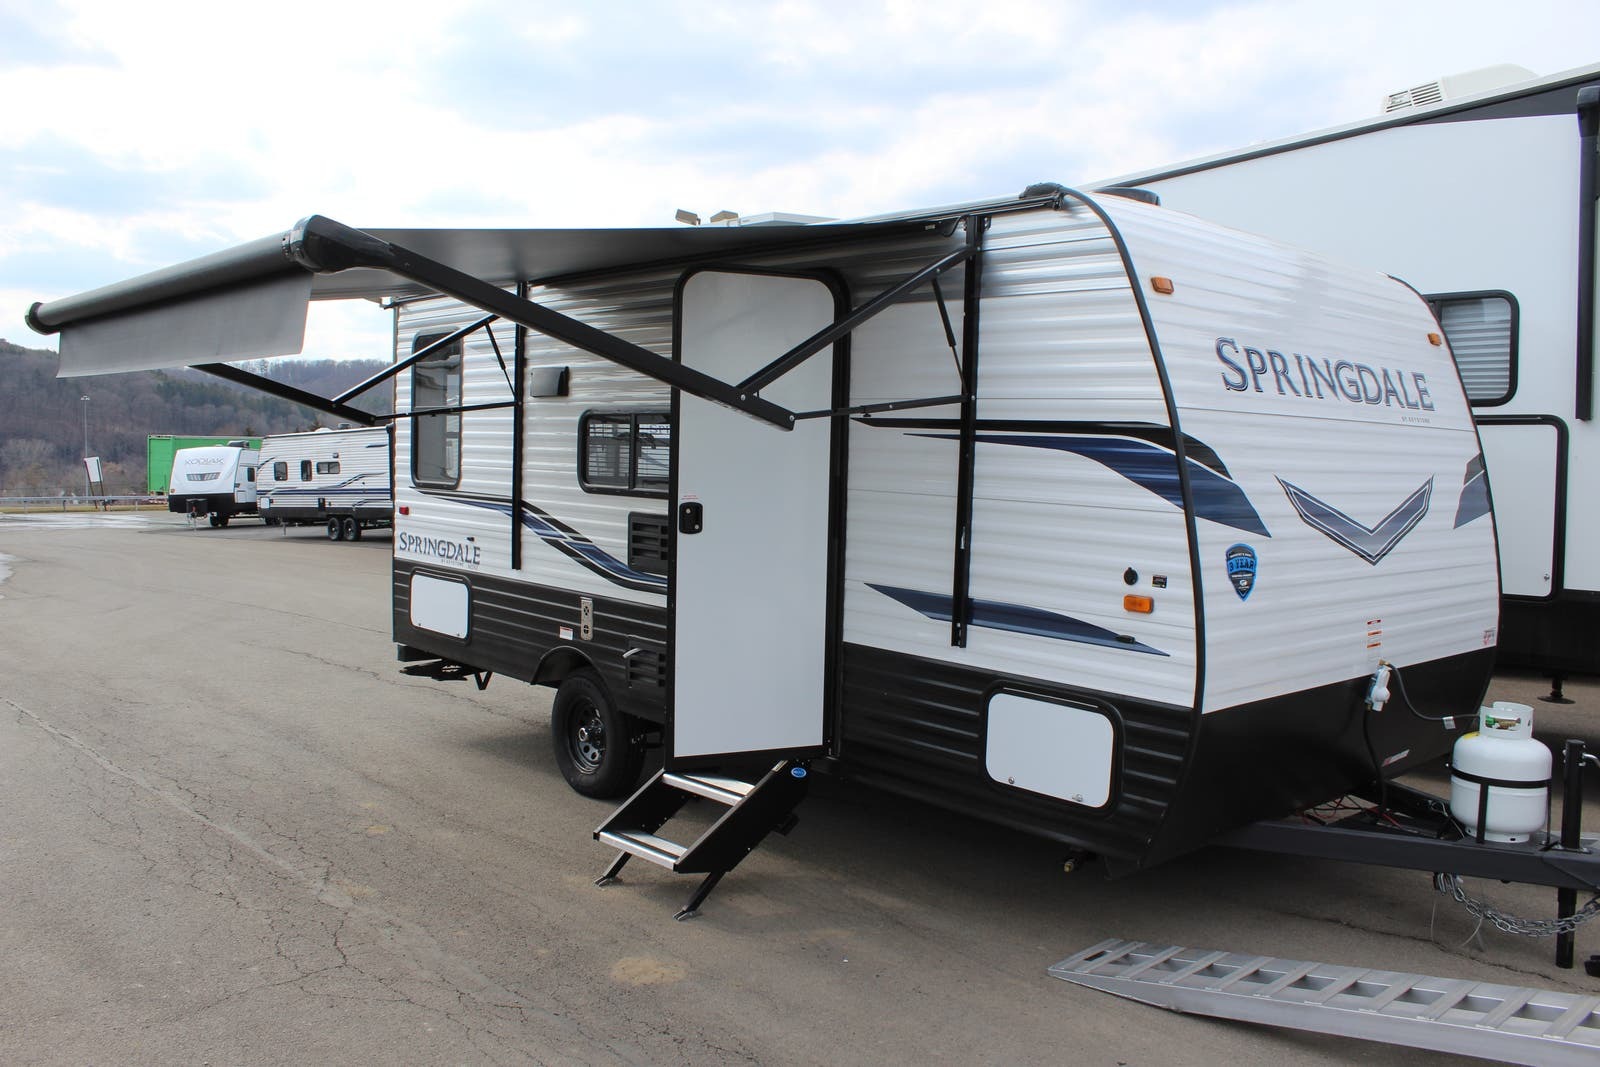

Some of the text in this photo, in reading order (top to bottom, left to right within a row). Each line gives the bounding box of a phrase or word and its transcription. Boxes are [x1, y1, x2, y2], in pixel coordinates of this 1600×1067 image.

[184, 456, 224, 465] KODIAK
[1229, 558, 1255, 572] 3 YEAR
